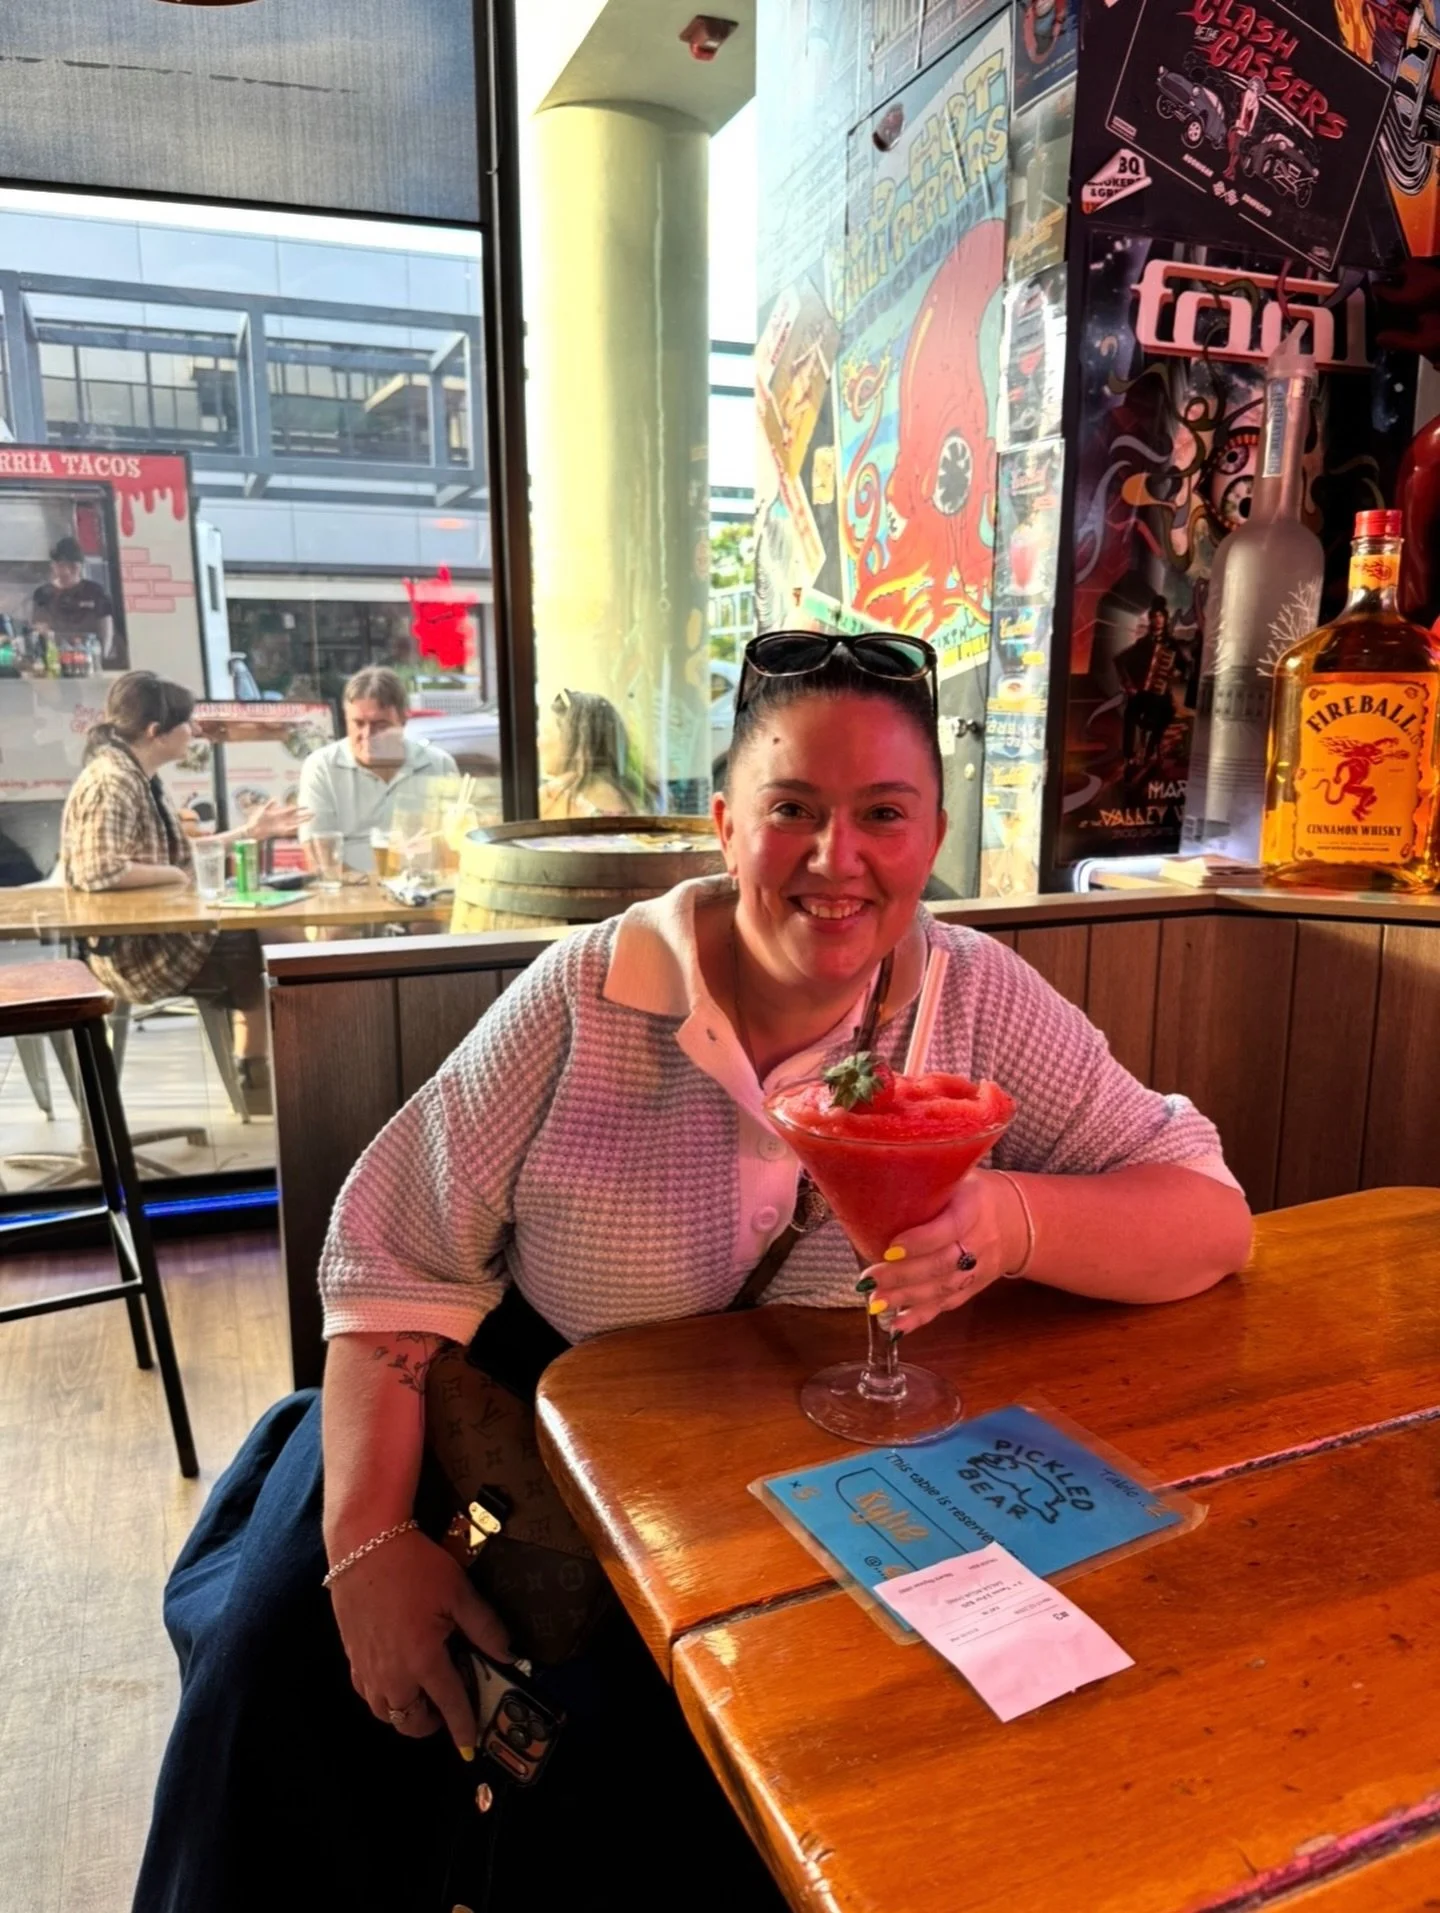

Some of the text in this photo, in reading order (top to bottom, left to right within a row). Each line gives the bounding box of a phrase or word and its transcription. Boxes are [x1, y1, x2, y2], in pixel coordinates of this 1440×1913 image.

[1192, 0, 1299, 60] CLASH
[1206, 29, 1348, 139] GASSERS
[61, 452, 141, 478] TACOS
[1305, 694, 1418, 735] FIREBALL
[1306, 823, 1402, 837] CINNAMON WHISKY
[885, 1453, 913, 1474] This
[909, 1472, 941, 1497] table
[936, 1495, 953, 1507] is
[958, 1467, 1030, 1520] BEAR
[995, 1439, 1095, 1512] PICKLED
